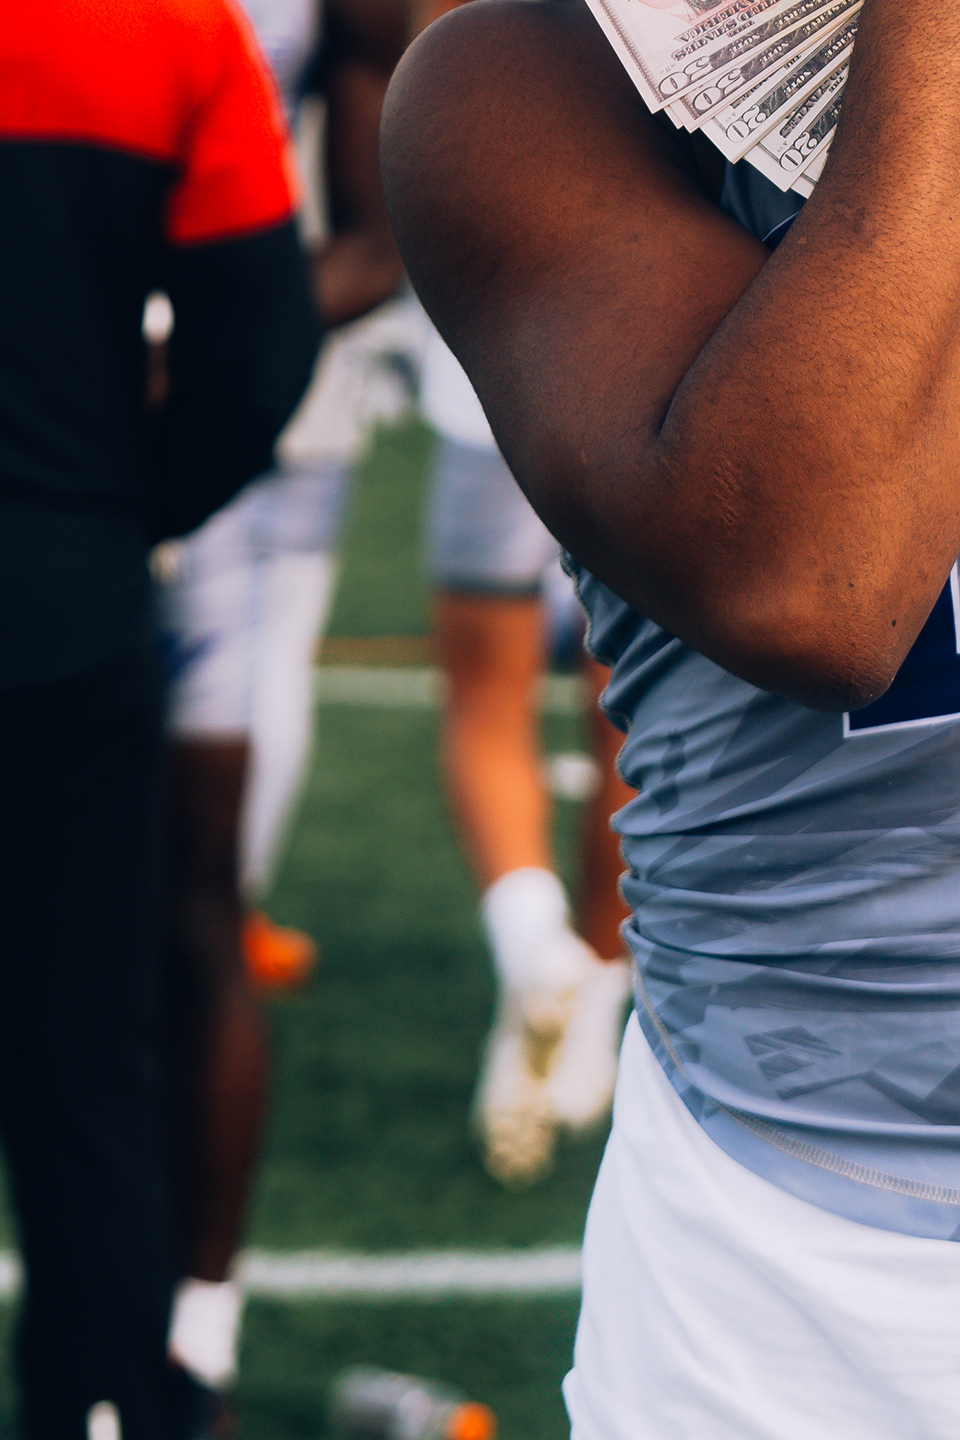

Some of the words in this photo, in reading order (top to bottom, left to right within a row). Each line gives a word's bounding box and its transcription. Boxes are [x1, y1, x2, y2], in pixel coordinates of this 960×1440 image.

[672, 18, 738, 62] STATES
[726, 20, 756, 38] THE
[728, 32, 762, 56] NOTE
[760, 40, 790, 65] NOTE
[658, 56, 710, 96] 50
[692, 68, 742, 111] 50
[784, 68, 812, 96] NOTE
[828, 76, 844, 94] THE
[726, 105, 766, 144] 20
[780, 132, 818, 172] 20
